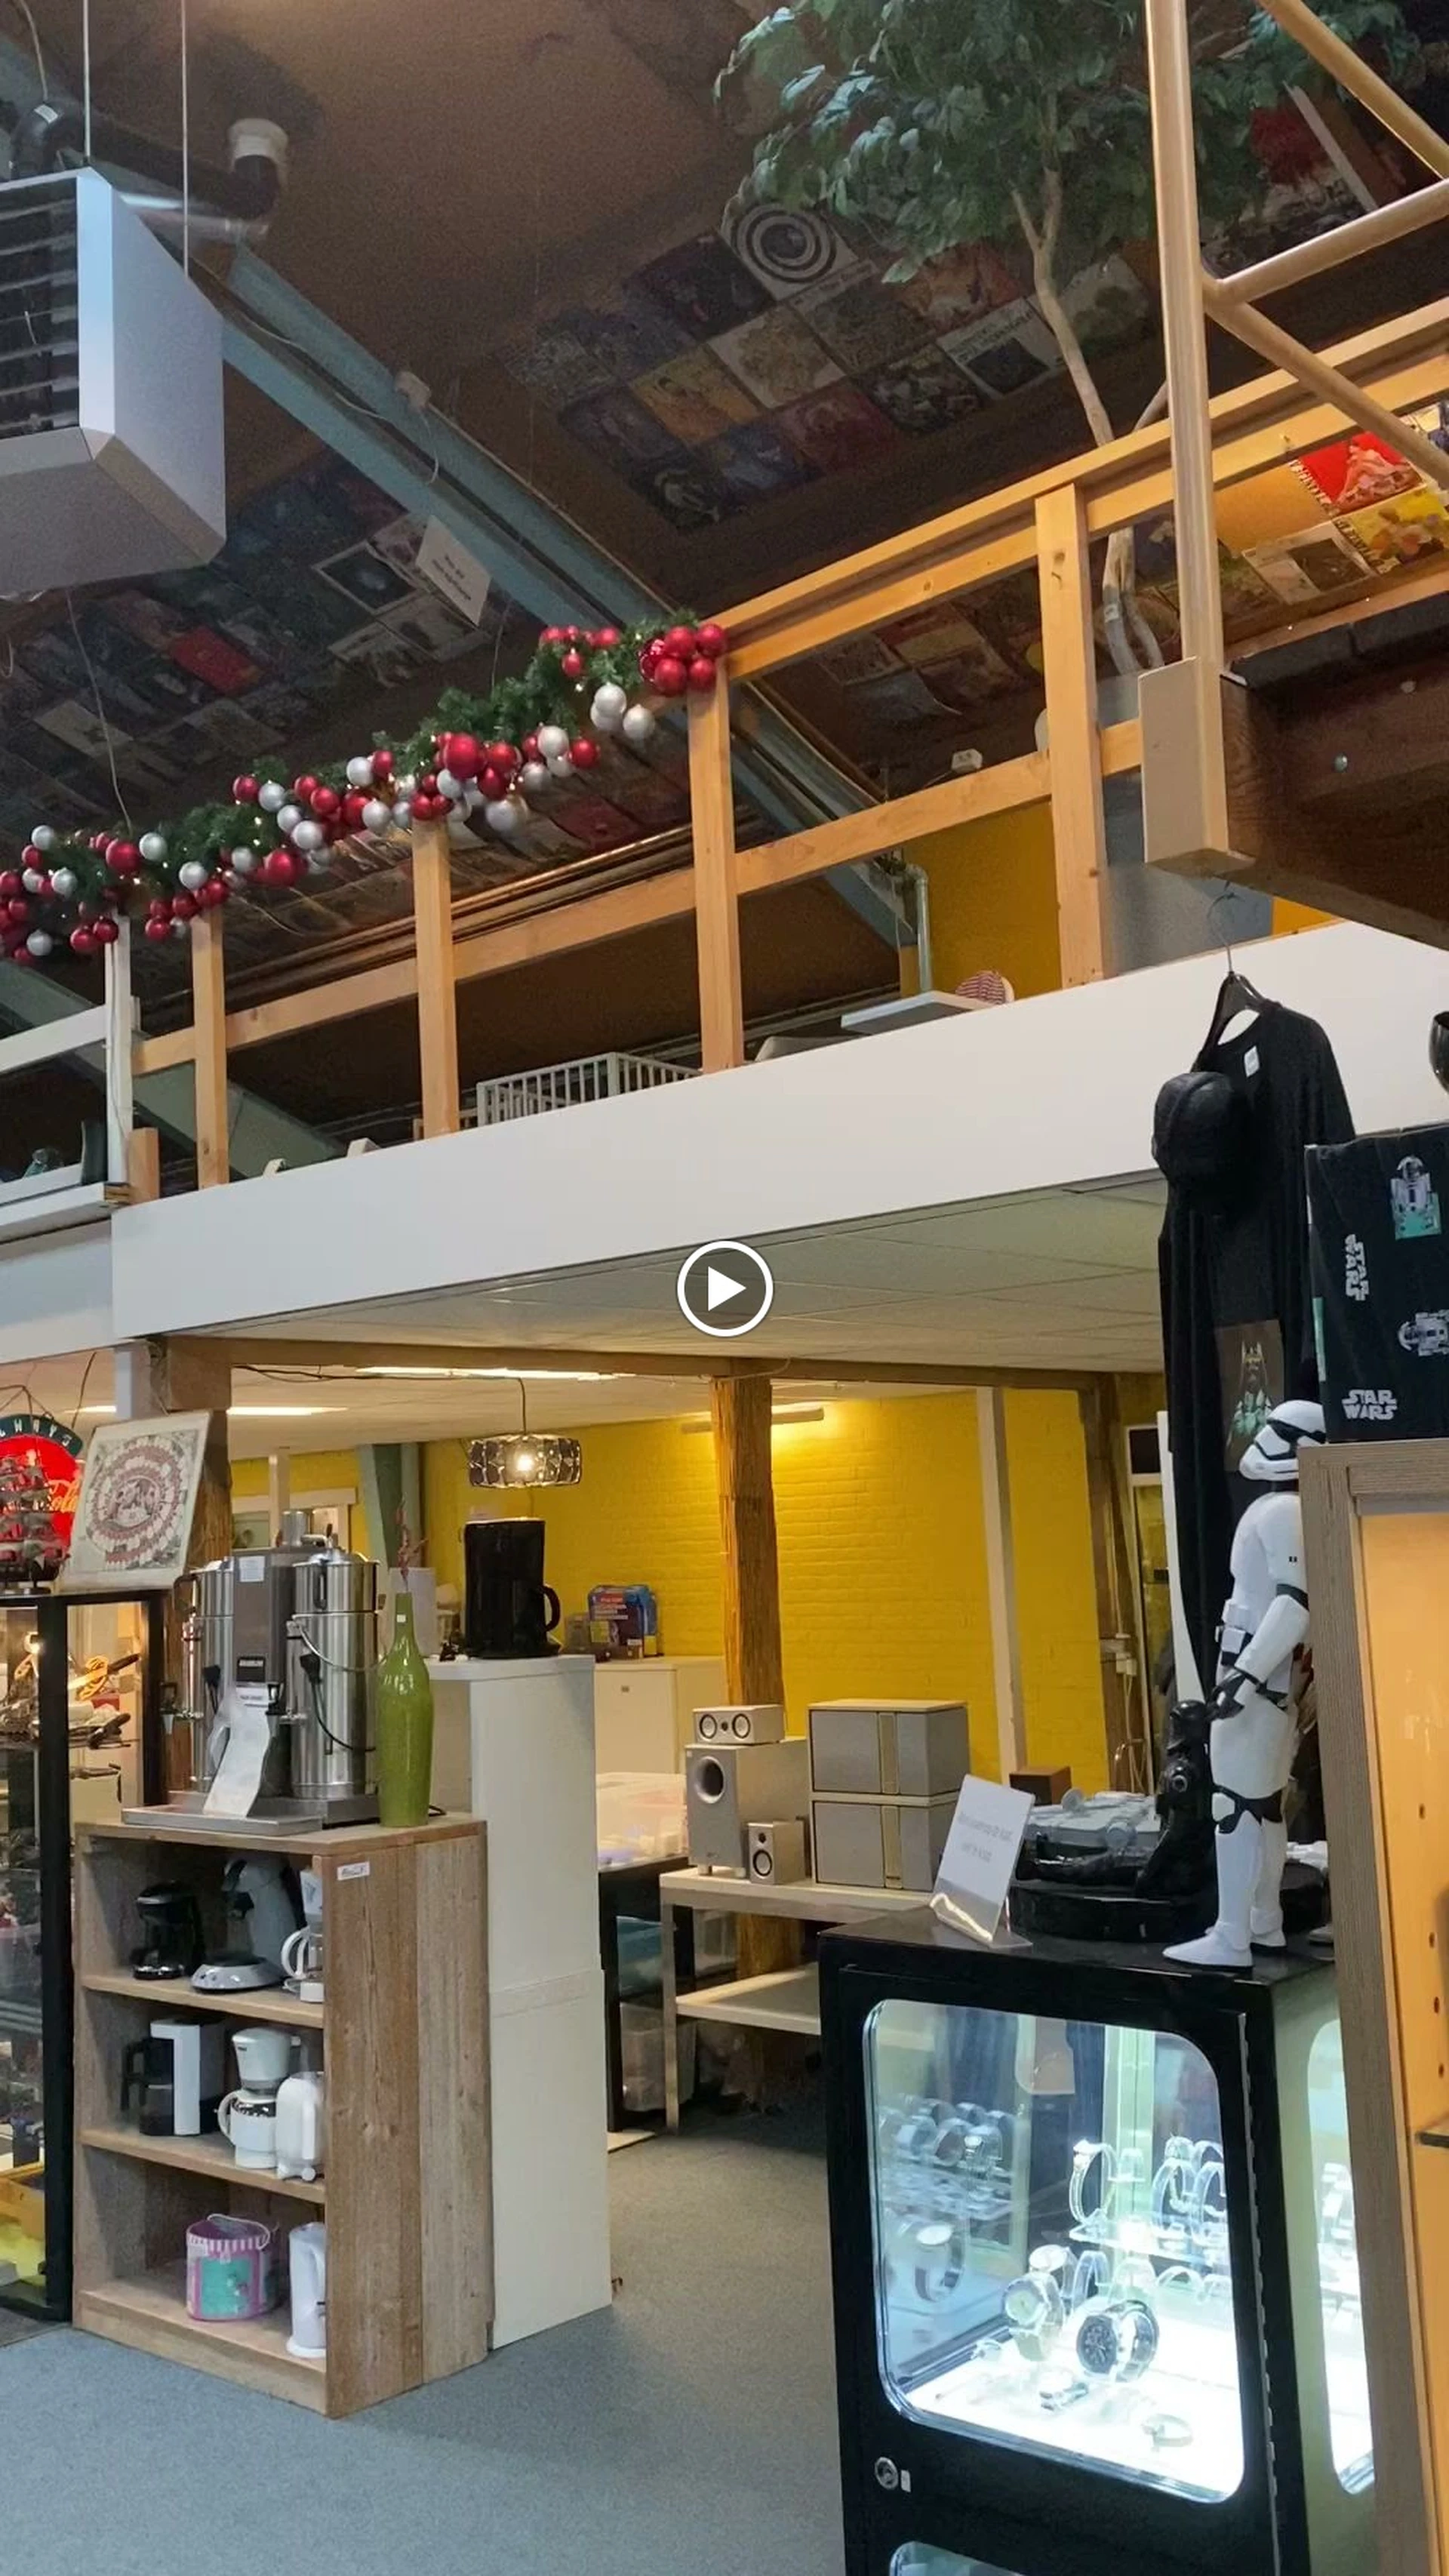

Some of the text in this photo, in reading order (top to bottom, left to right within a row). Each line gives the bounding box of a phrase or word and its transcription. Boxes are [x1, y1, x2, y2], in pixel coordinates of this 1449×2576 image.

[1345, 1233, 1361, 1300] WARS
[1354, 1242, 1369, 1300] STAR
[1342, 1390, 1396, 1405] STAR
[1343, 1405, 1397, 1420] WARS
